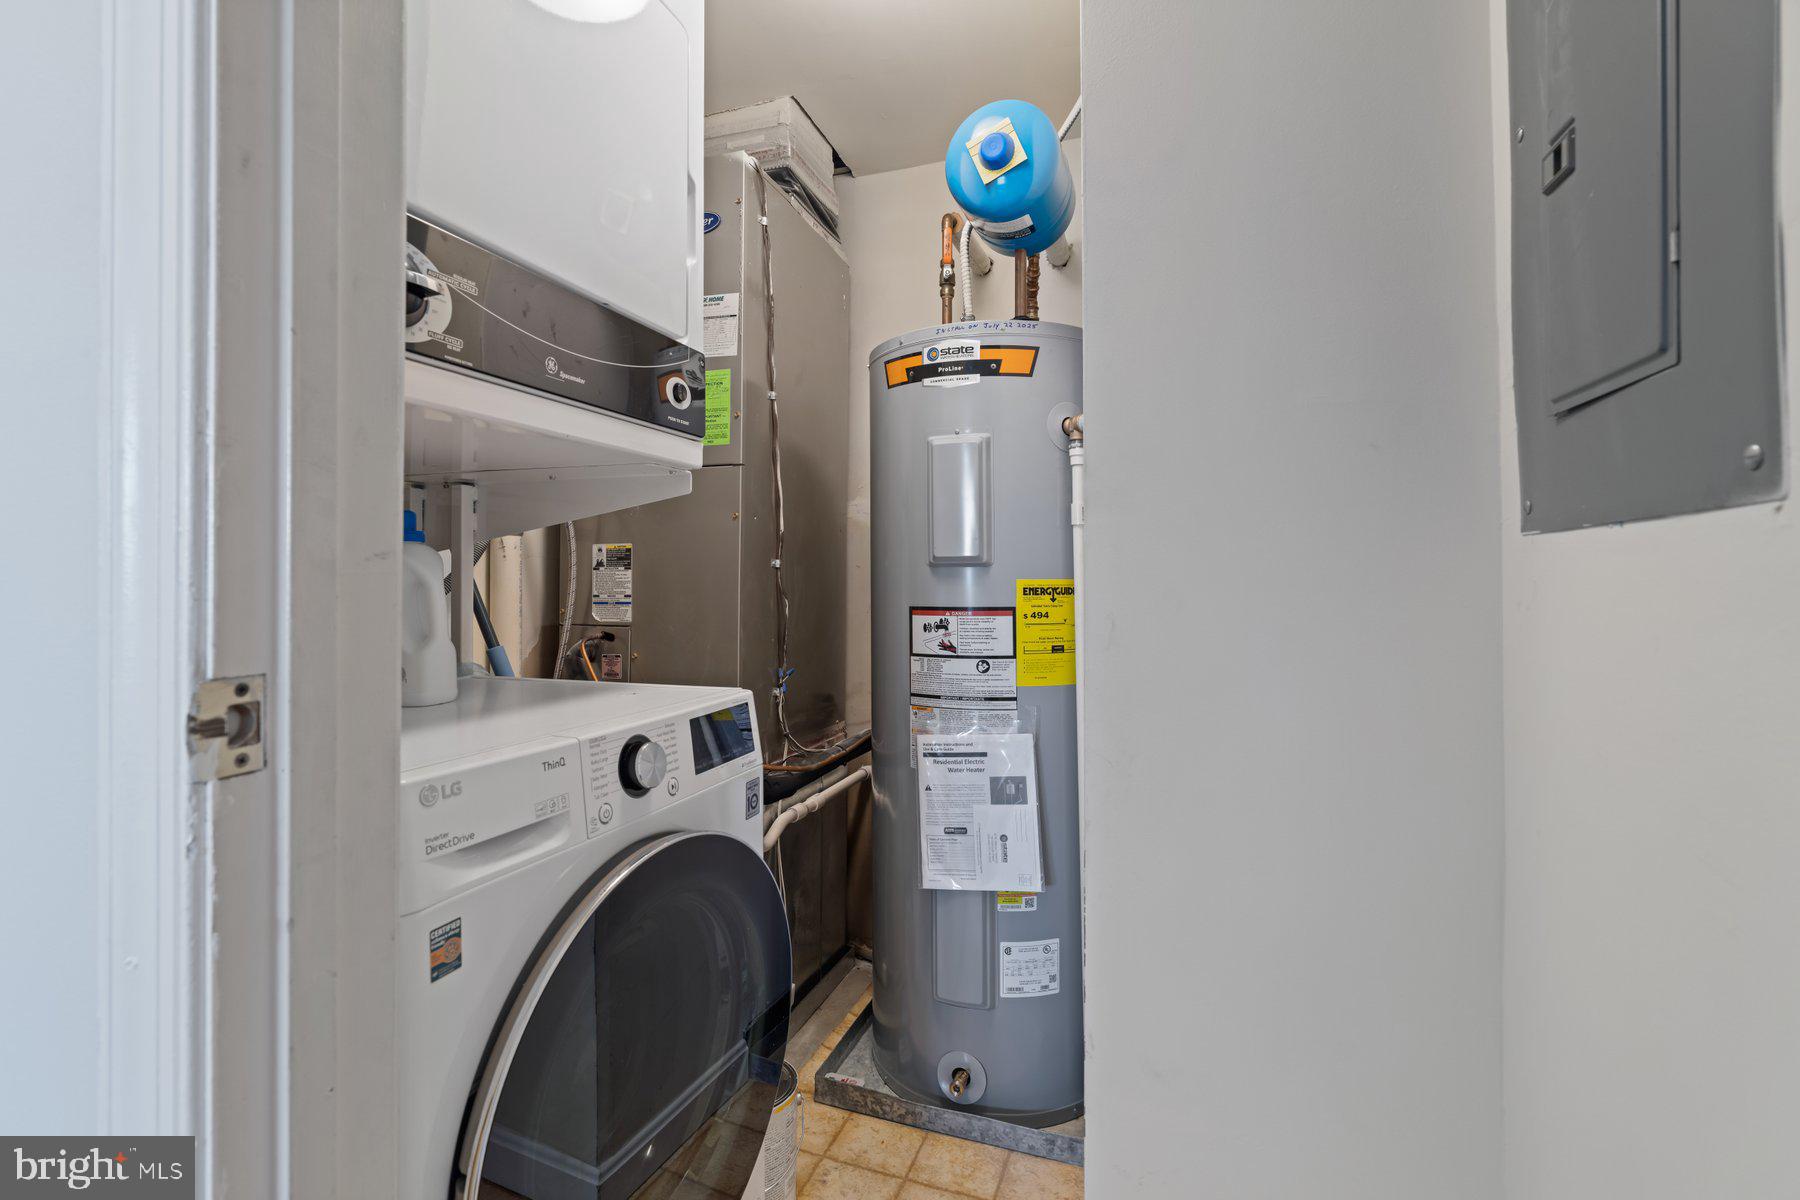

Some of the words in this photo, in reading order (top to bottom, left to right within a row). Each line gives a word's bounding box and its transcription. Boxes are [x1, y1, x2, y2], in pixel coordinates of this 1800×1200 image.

[940, 345, 975, 356] state
[542, 756, 566, 772] ThinQ
[441, 781, 463, 800] LG
